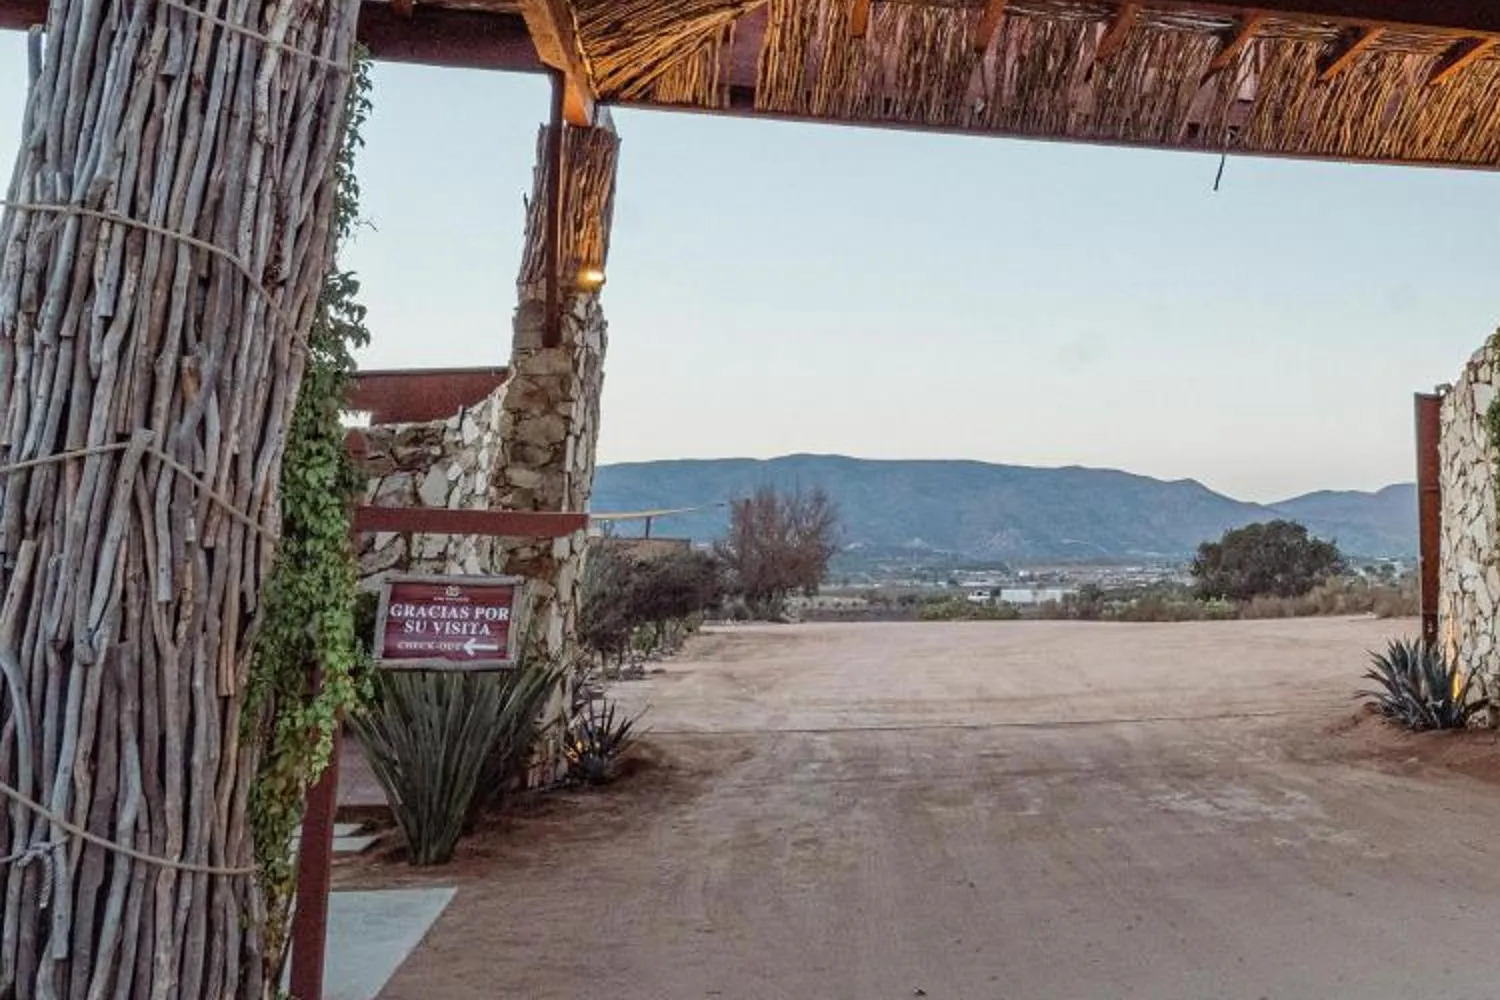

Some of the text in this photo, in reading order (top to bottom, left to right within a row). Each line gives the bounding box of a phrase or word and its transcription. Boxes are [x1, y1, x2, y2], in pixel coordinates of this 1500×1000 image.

[390, 604, 509, 620] GRACIAS POR
[404, 619, 490, 635] SU VISITA
